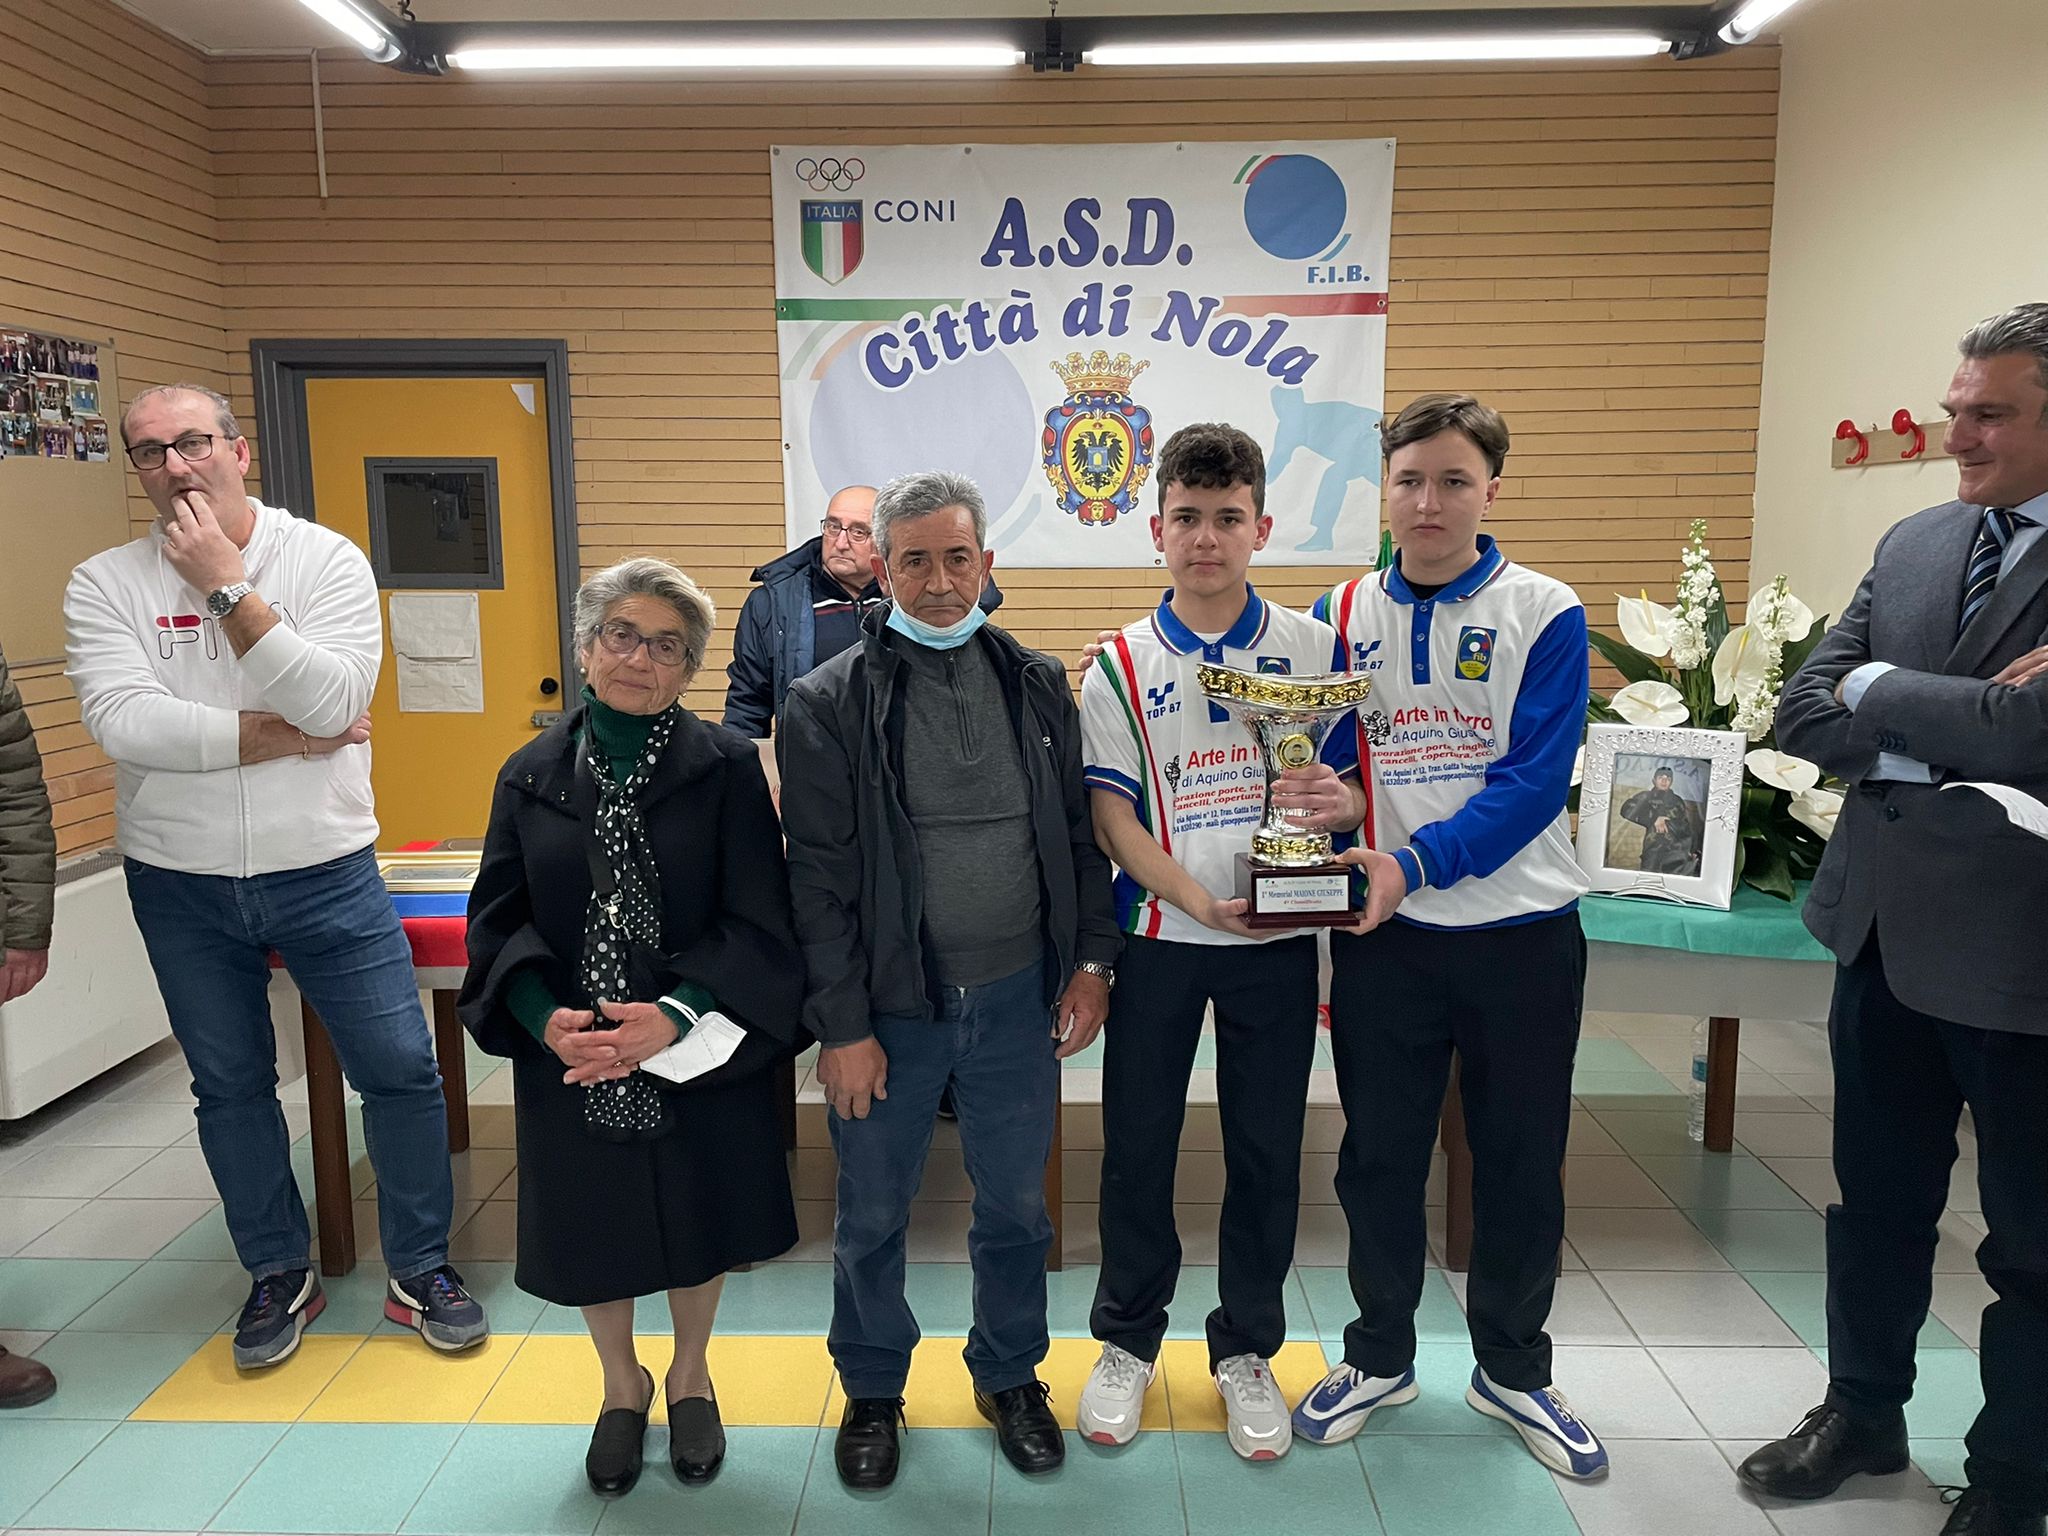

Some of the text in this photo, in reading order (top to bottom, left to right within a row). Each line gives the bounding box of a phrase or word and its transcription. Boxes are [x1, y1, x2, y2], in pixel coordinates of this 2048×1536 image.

[807, 206, 858, 218] ITALIA
[874, 199, 955, 223] CONI
[980, 197, 1193, 268] A.S.D.
[1308, 265, 1370, 284] F.I.B.
[865, 282, 1319, 388] Città di Nola
[1146, 701, 1181, 720] TOP 87
[1393, 706, 1429, 727] Arte
[1433, 705, 1449, 723] in
[1402, 727, 1444, 743] Aquino
[1186, 749, 1225, 770] Arte
[1231, 744, 1247, 763] in
[1181, 774, 1193, 788] di
[1195, 769, 1238, 786] Aquino
